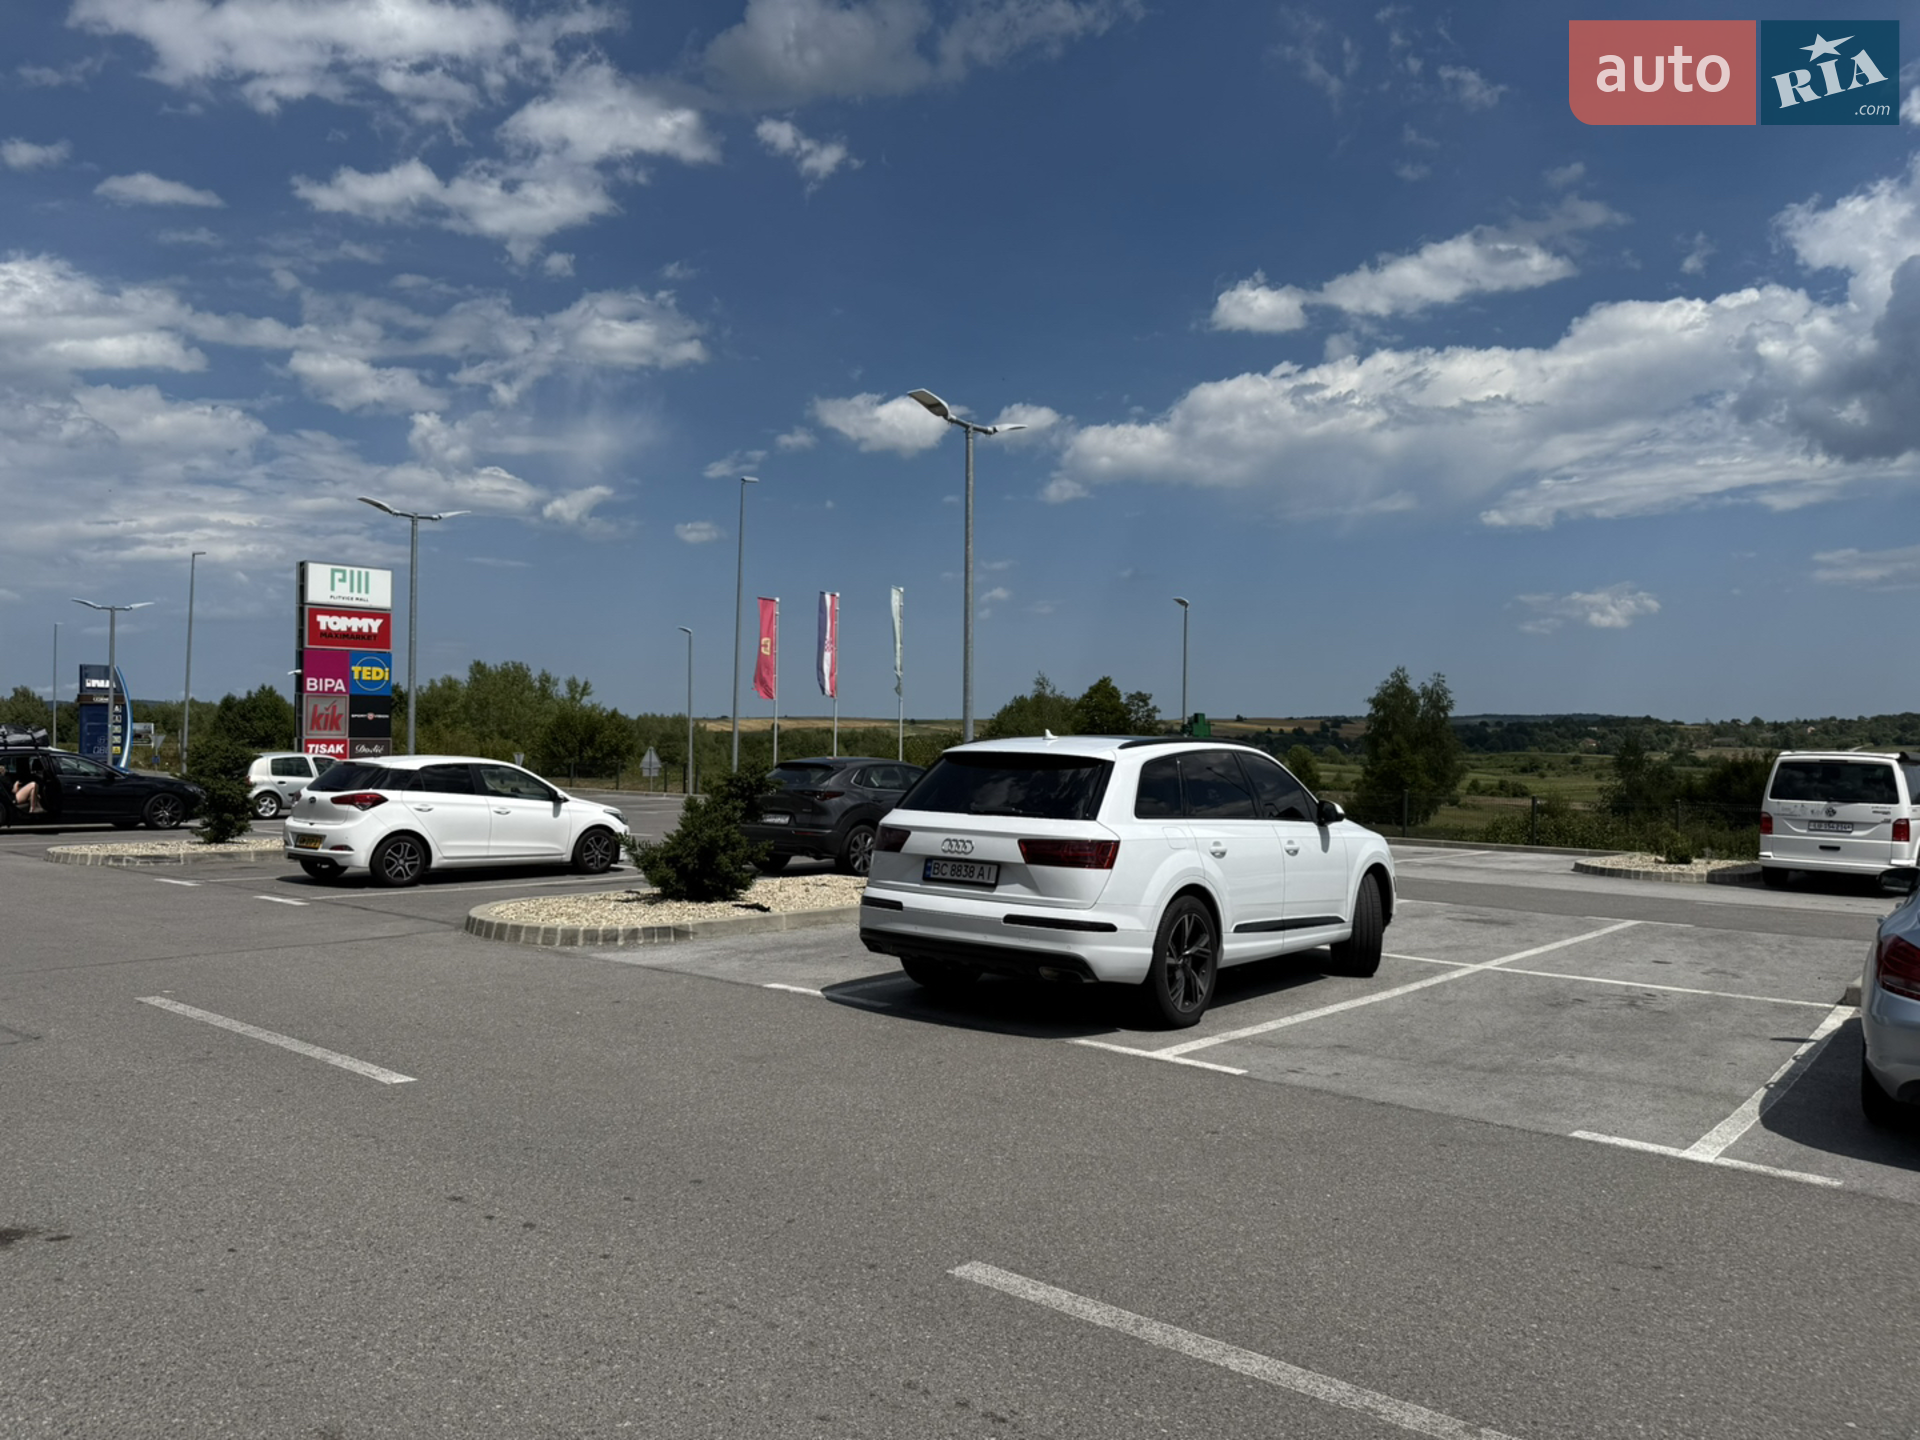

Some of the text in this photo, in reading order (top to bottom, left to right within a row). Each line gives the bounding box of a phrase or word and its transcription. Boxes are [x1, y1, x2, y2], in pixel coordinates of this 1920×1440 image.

[316, 614, 384, 634] TOMMY
[319, 631, 378, 641] MAXIMARKET
[351, 666, 390, 681] TEDi
[306, 677, 347, 693] BIPA
[307, 743, 345, 755] TISAK
[932, 862, 948, 876] BC
[950, 864, 975, 878] 8838
